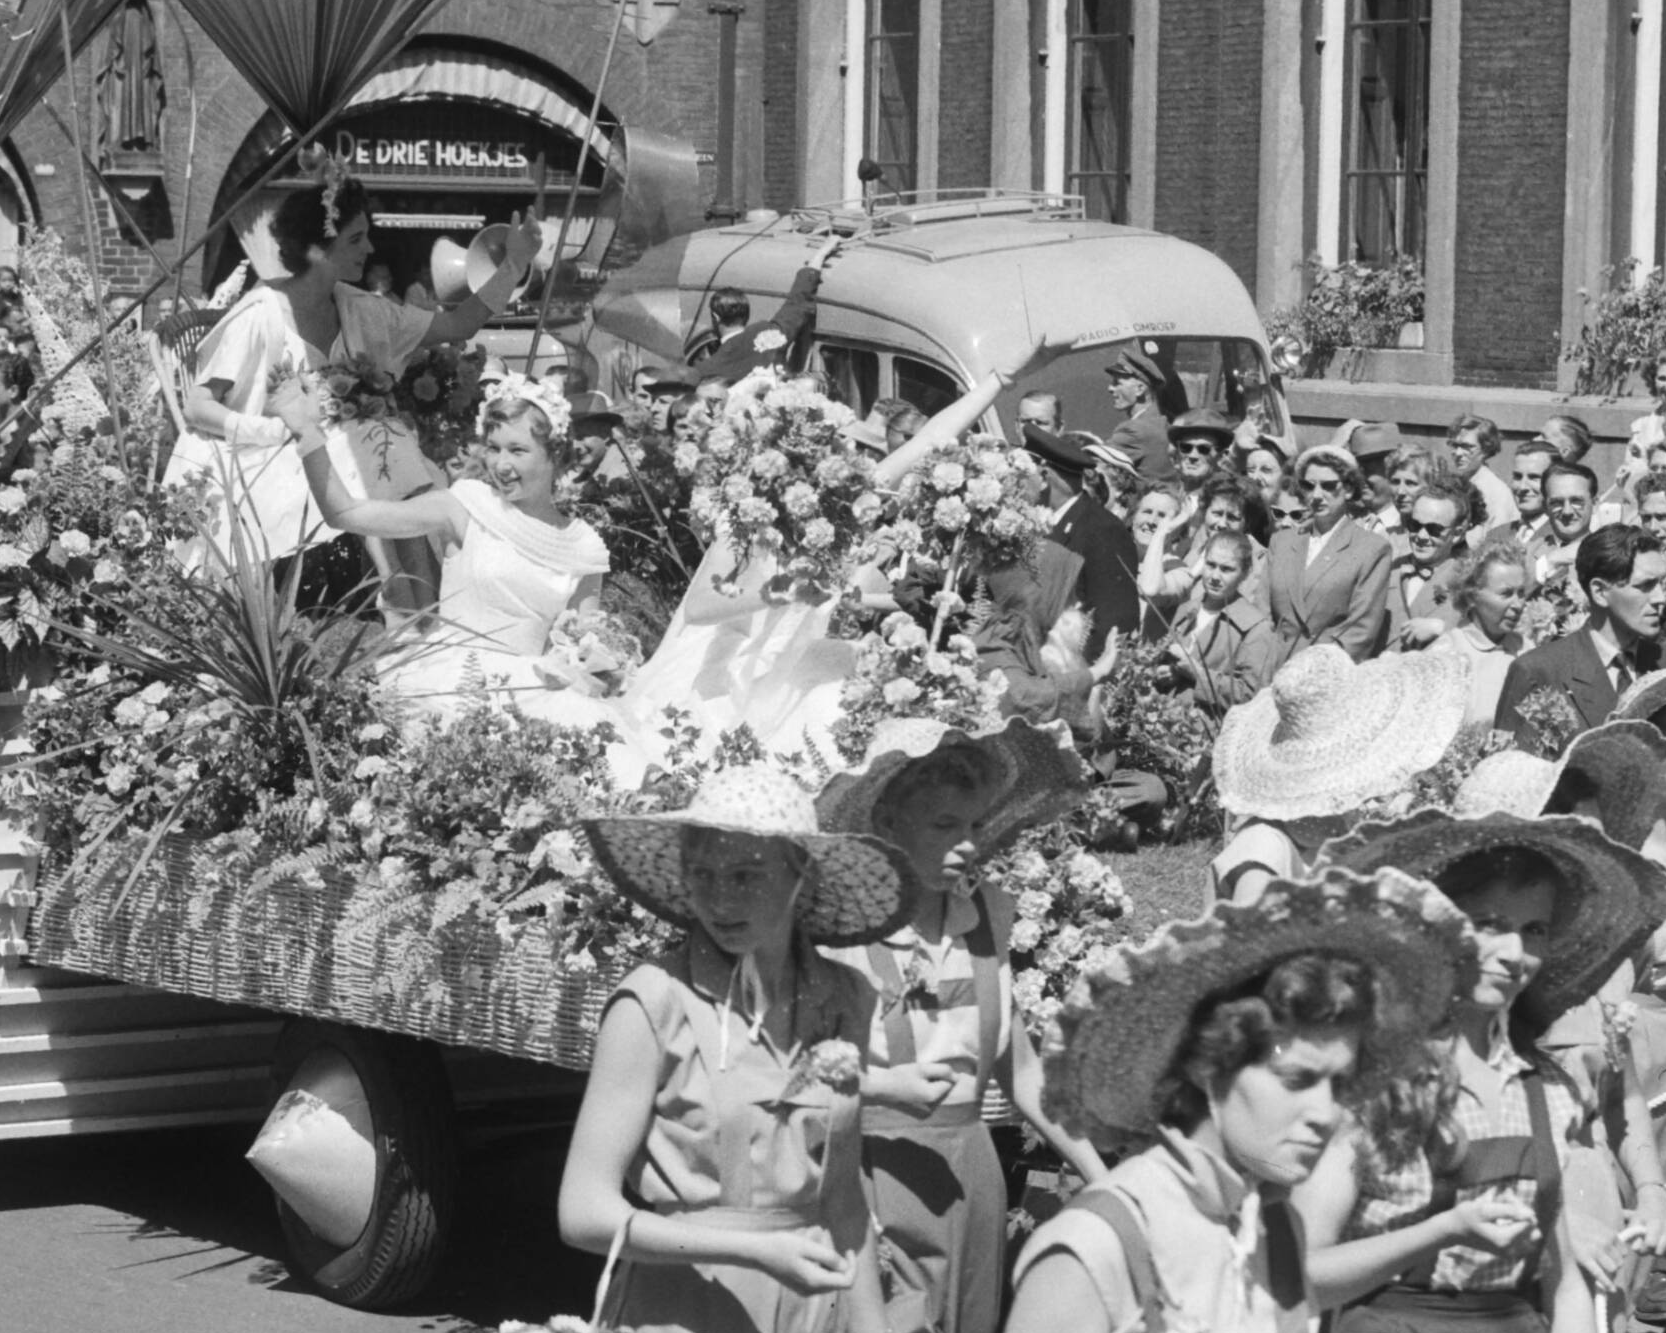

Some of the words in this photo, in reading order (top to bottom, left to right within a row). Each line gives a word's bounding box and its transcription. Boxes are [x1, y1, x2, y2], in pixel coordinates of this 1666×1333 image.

[376, 138, 429, 165] DRIE
[434, 140, 528, 168] HOEKJES
[1079, 325, 1120, 342] RADIO
